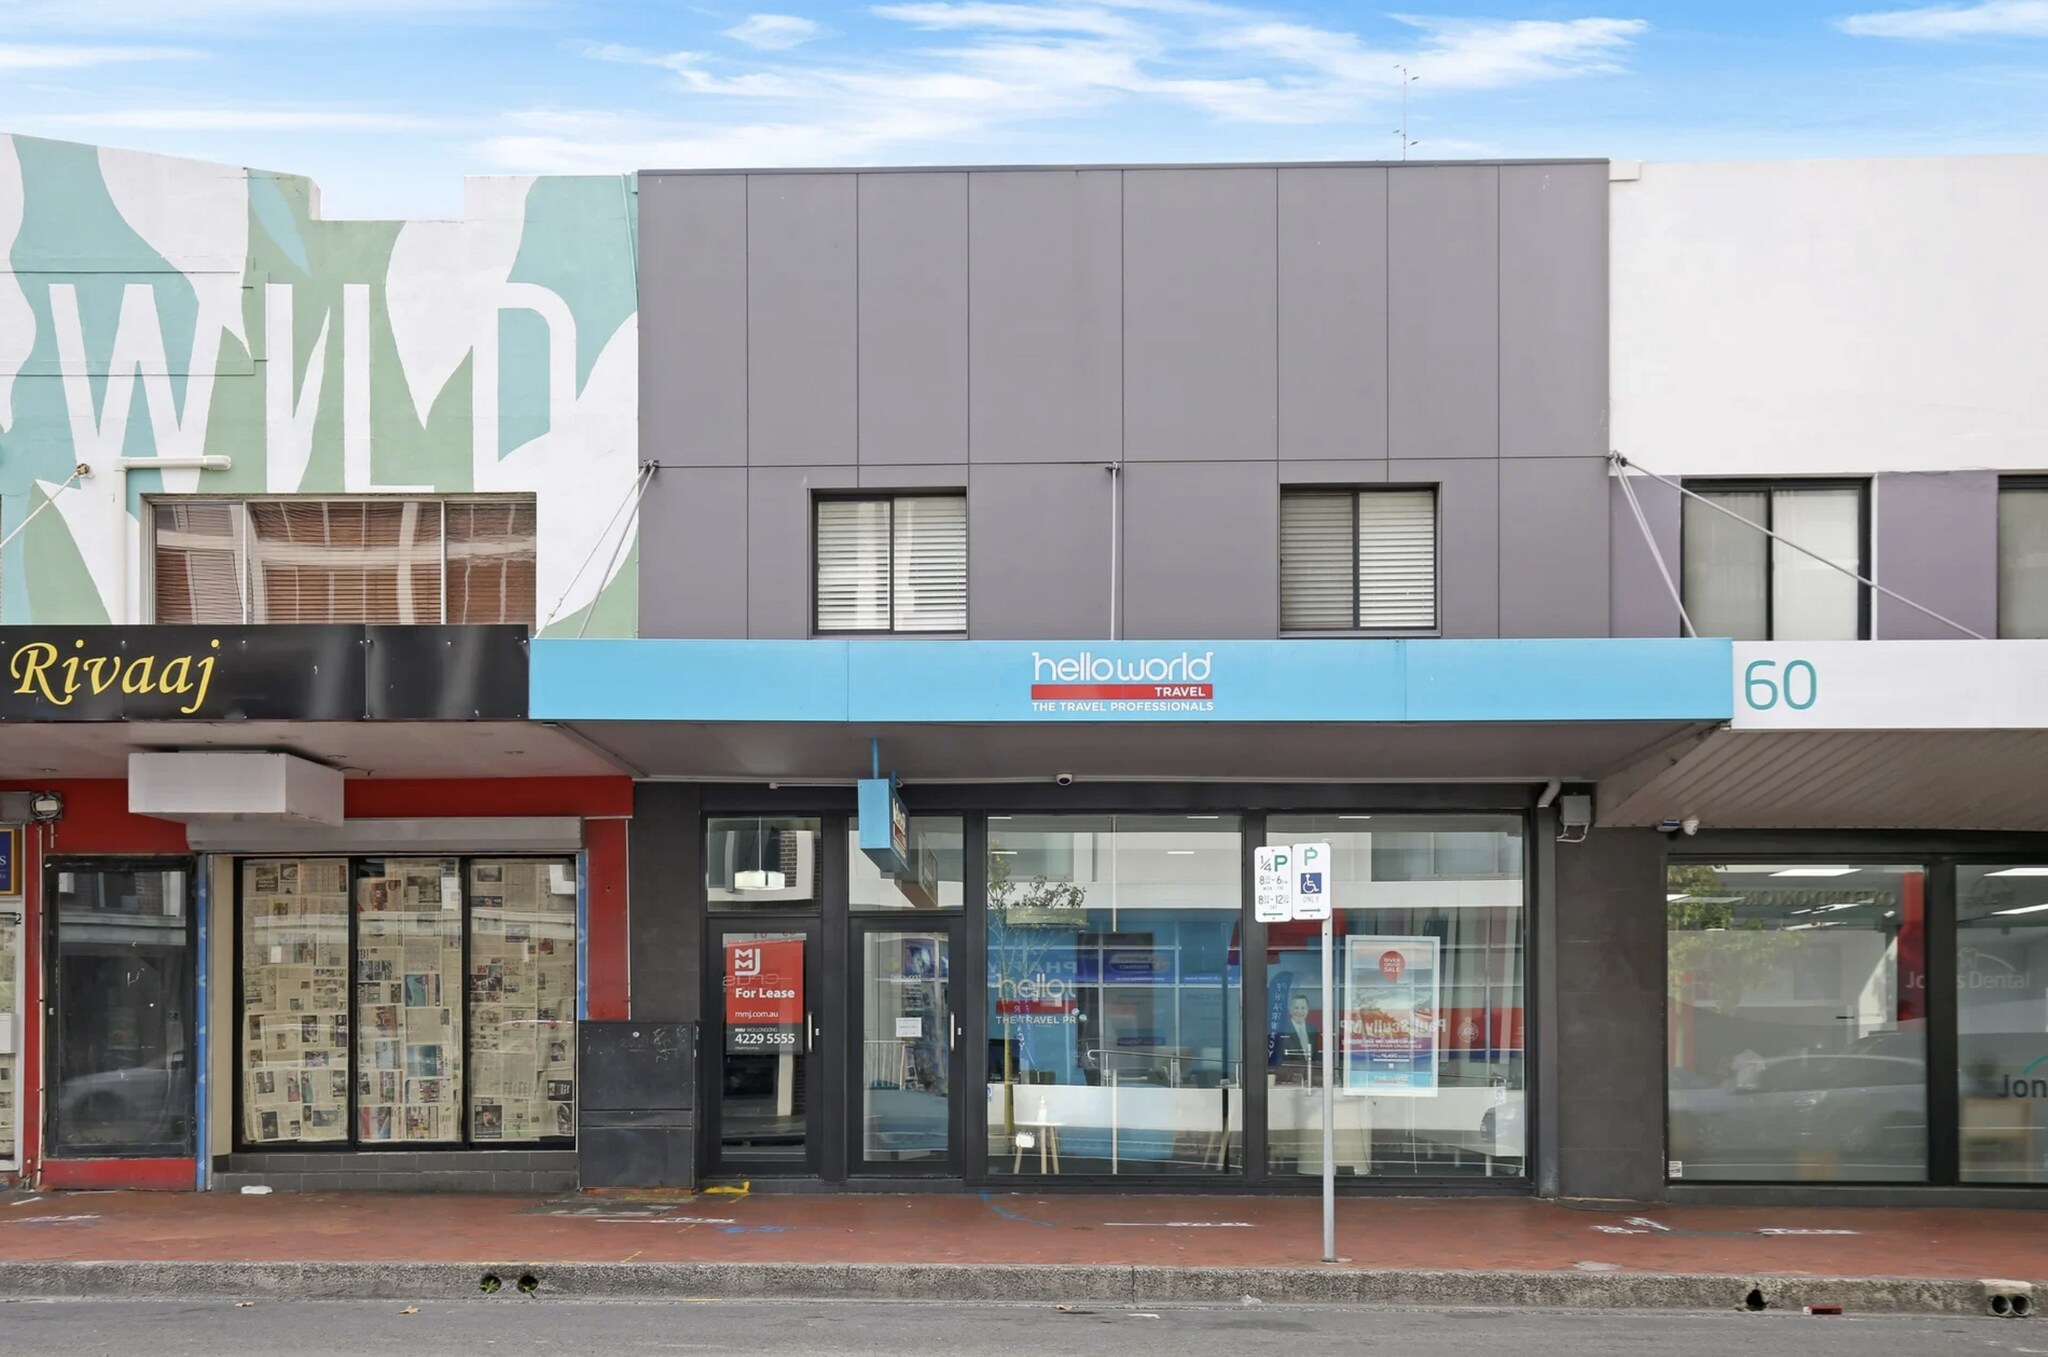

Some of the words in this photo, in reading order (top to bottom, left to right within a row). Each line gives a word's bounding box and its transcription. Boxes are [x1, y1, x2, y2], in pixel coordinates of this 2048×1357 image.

[10, 639, 220, 714] Rivaaj
[1744, 659, 1817, 711] 60
[1154, 686, 1206, 697] TRAVEL
[1031, 702, 1056, 712] THE
[1060, 702, 1107, 712] TRAVEL
[1111, 702, 1214, 712] PROFESSIONALS
[1304, 848, 1319, 866] P
[1302, 896, 1320, 904] ONLY
[1905, 971, 1965, 989] Jos
[1970, 971, 2031, 989] Dental
[735, 988, 756, 999] For
[759, 988, 795, 999] Lease
[735, 1011, 779, 1020] mmj.com.au
[996, 1016, 1016, 1025] THE
[1018, 1016, 1060, 1025] TRAVEL
[735, 1033, 764, 1044] 4229
[766, 1033, 796, 1044] 5555
